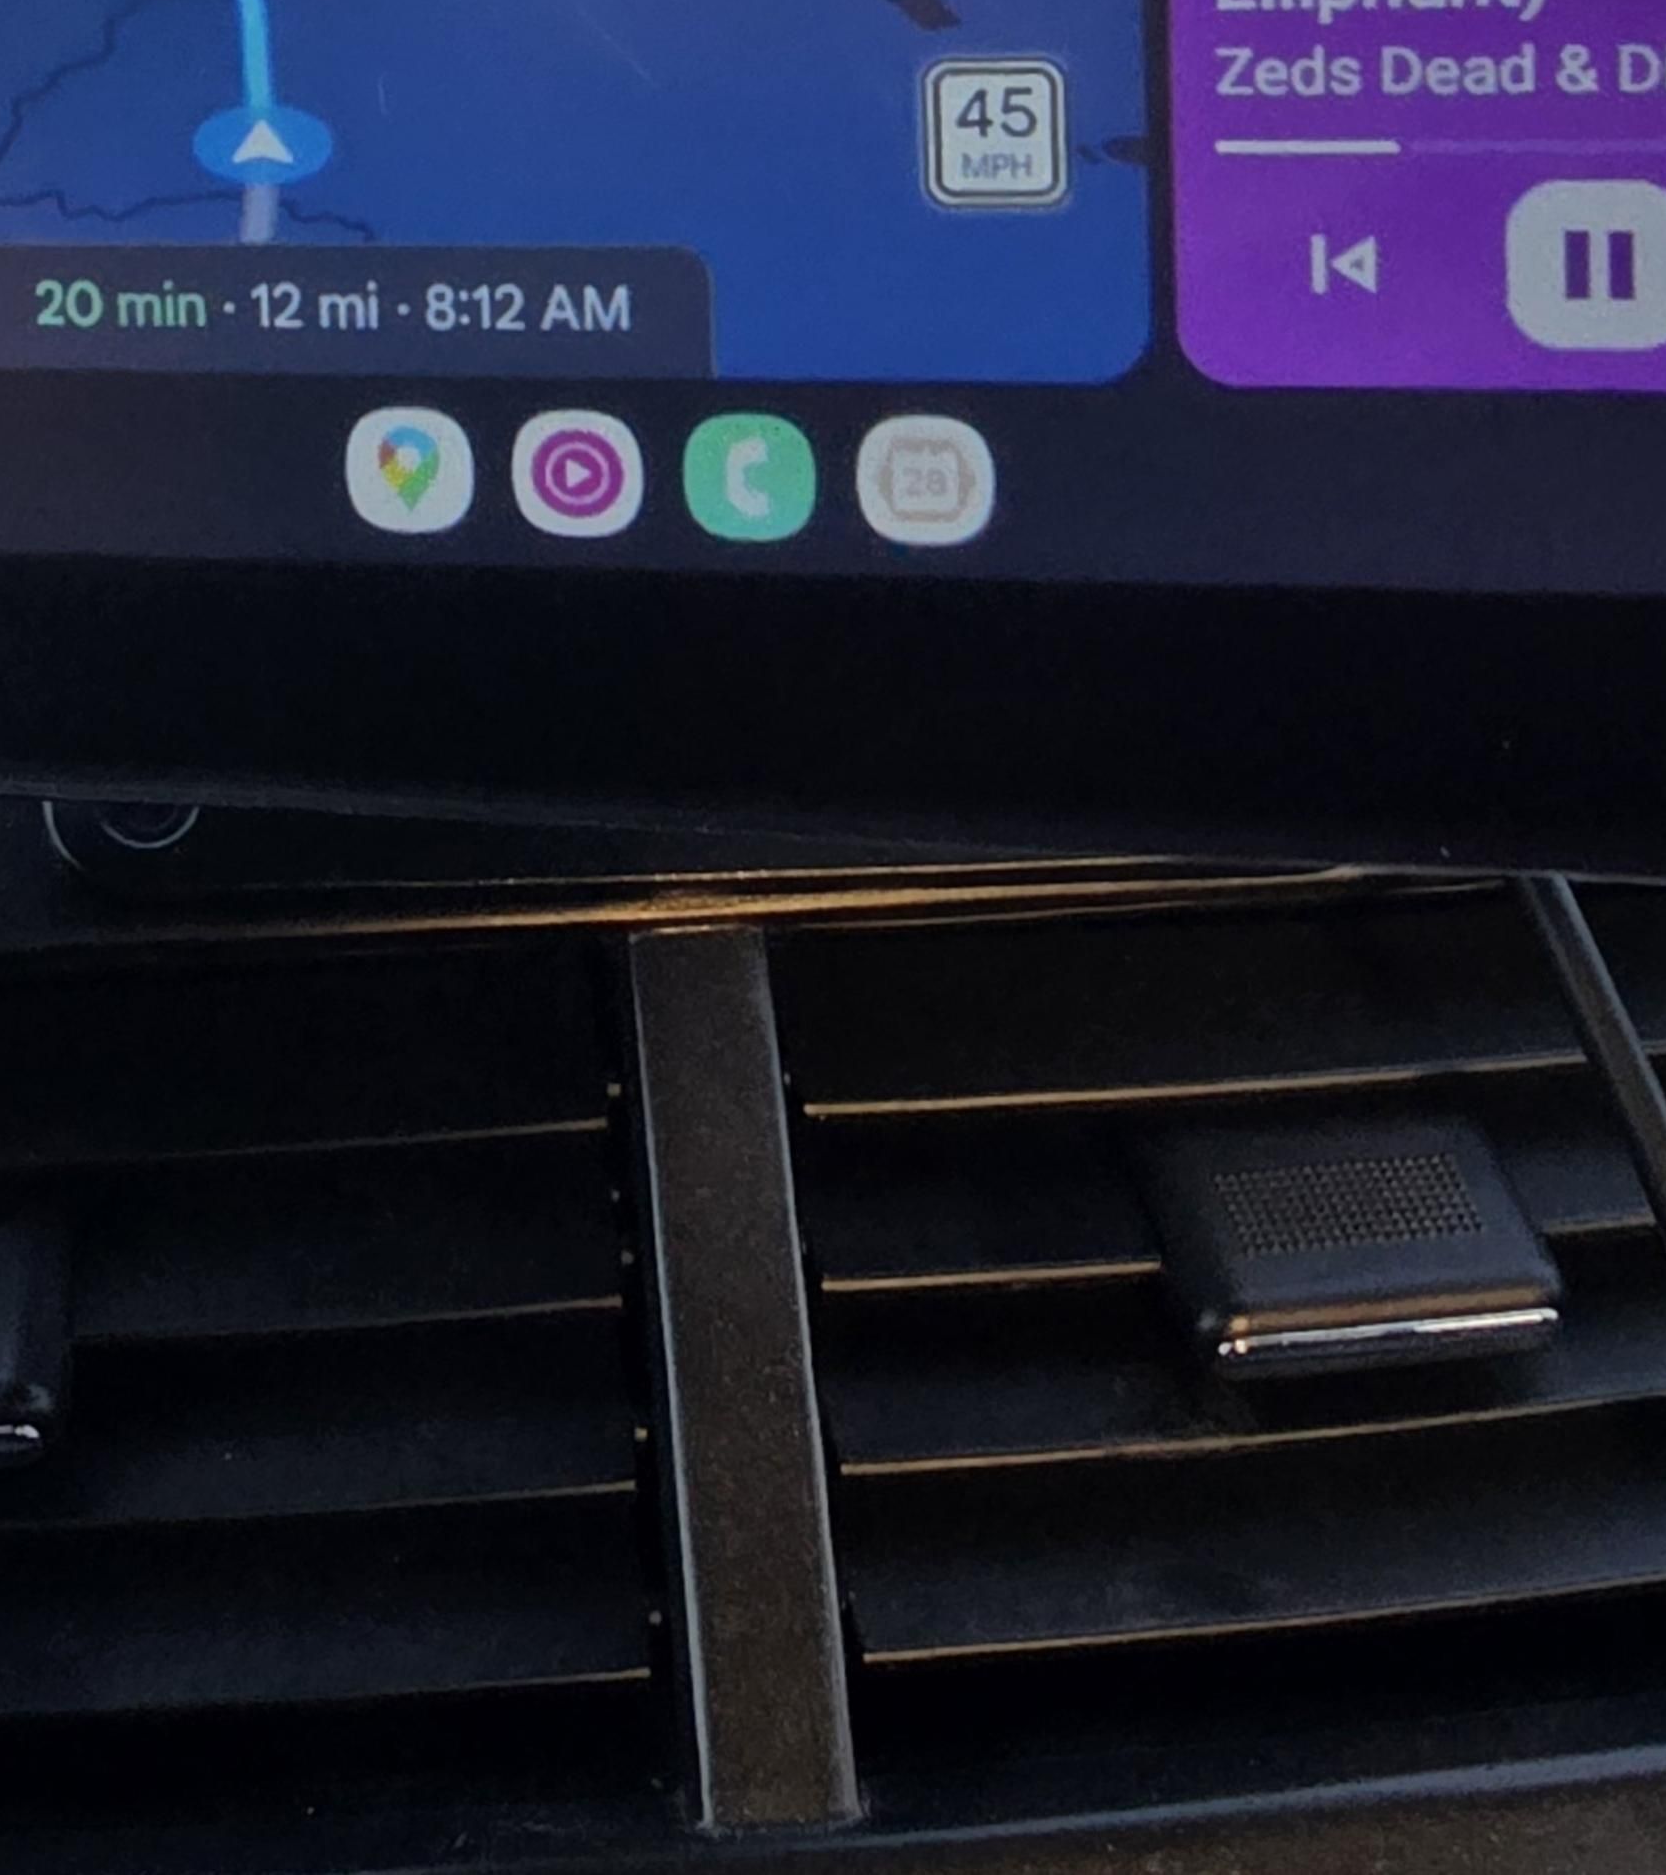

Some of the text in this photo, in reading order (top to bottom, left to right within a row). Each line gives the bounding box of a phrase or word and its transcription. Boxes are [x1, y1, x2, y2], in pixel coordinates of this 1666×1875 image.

[1215, 45, 1362, 97] Zeds
[1379, 43, 1536, 96] Dead
[1554, 45, 1600, 95] &
[955, 86, 1037, 139] 45
[961, 151, 1033, 180] MPH
[34, 278, 632, 333] 20 min 12 mi 8:12 AM
